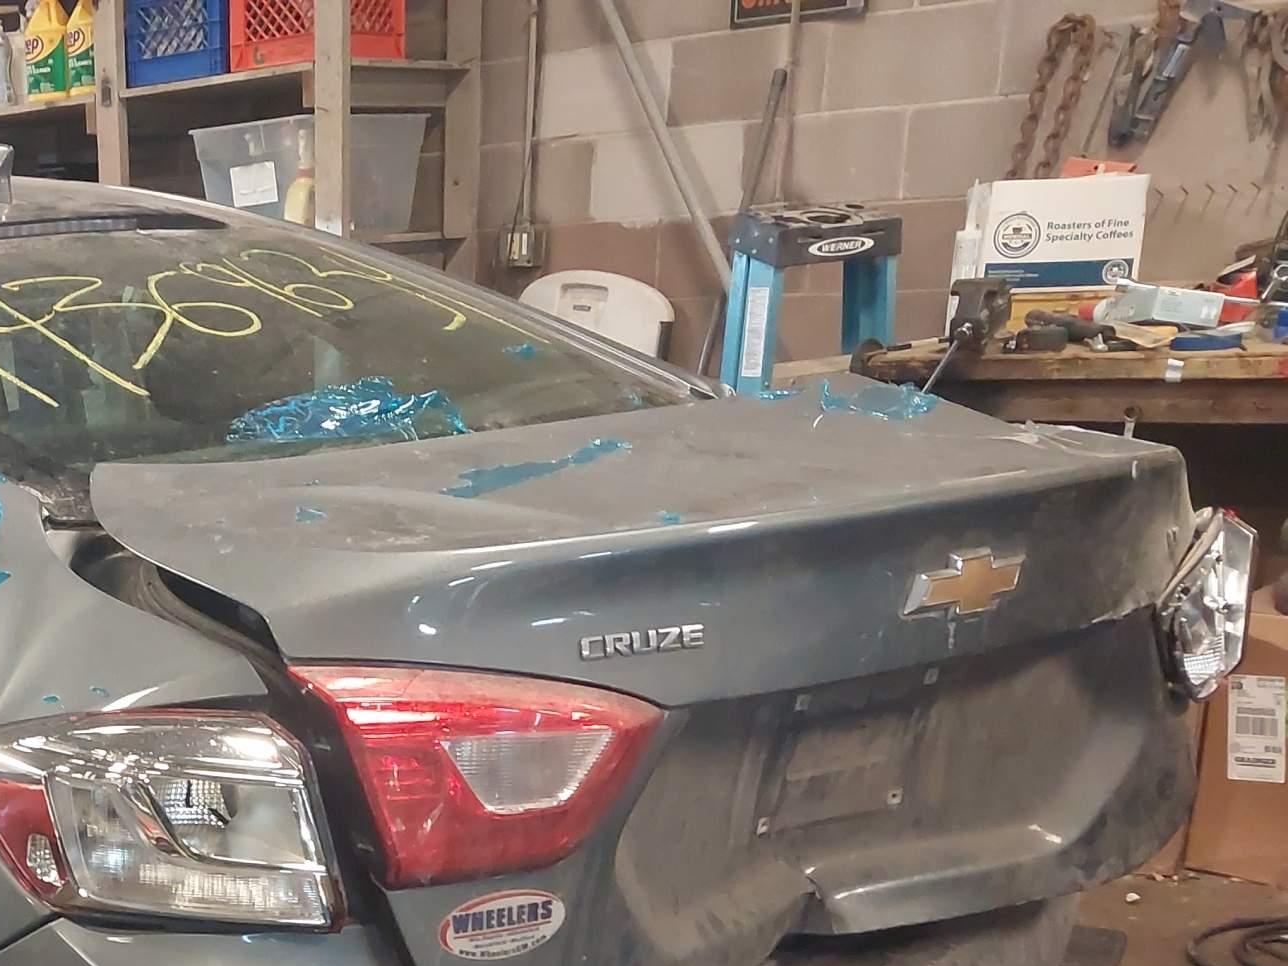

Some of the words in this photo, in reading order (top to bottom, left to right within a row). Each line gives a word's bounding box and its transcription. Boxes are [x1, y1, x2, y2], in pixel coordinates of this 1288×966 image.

[1046, 220, 1092, 230] Roasters
[1094, 218, 1106, 229] of
[1107, 218, 1131, 227] Fine
[1045, 231, 1094, 243] Specialty
[1095, 230, 1134, 240] Coffees
[820, 240, 863, 252] WERNER
[580, 623, 705, 660] CRUZE
[452, 900, 553, 934] WHEELERS
